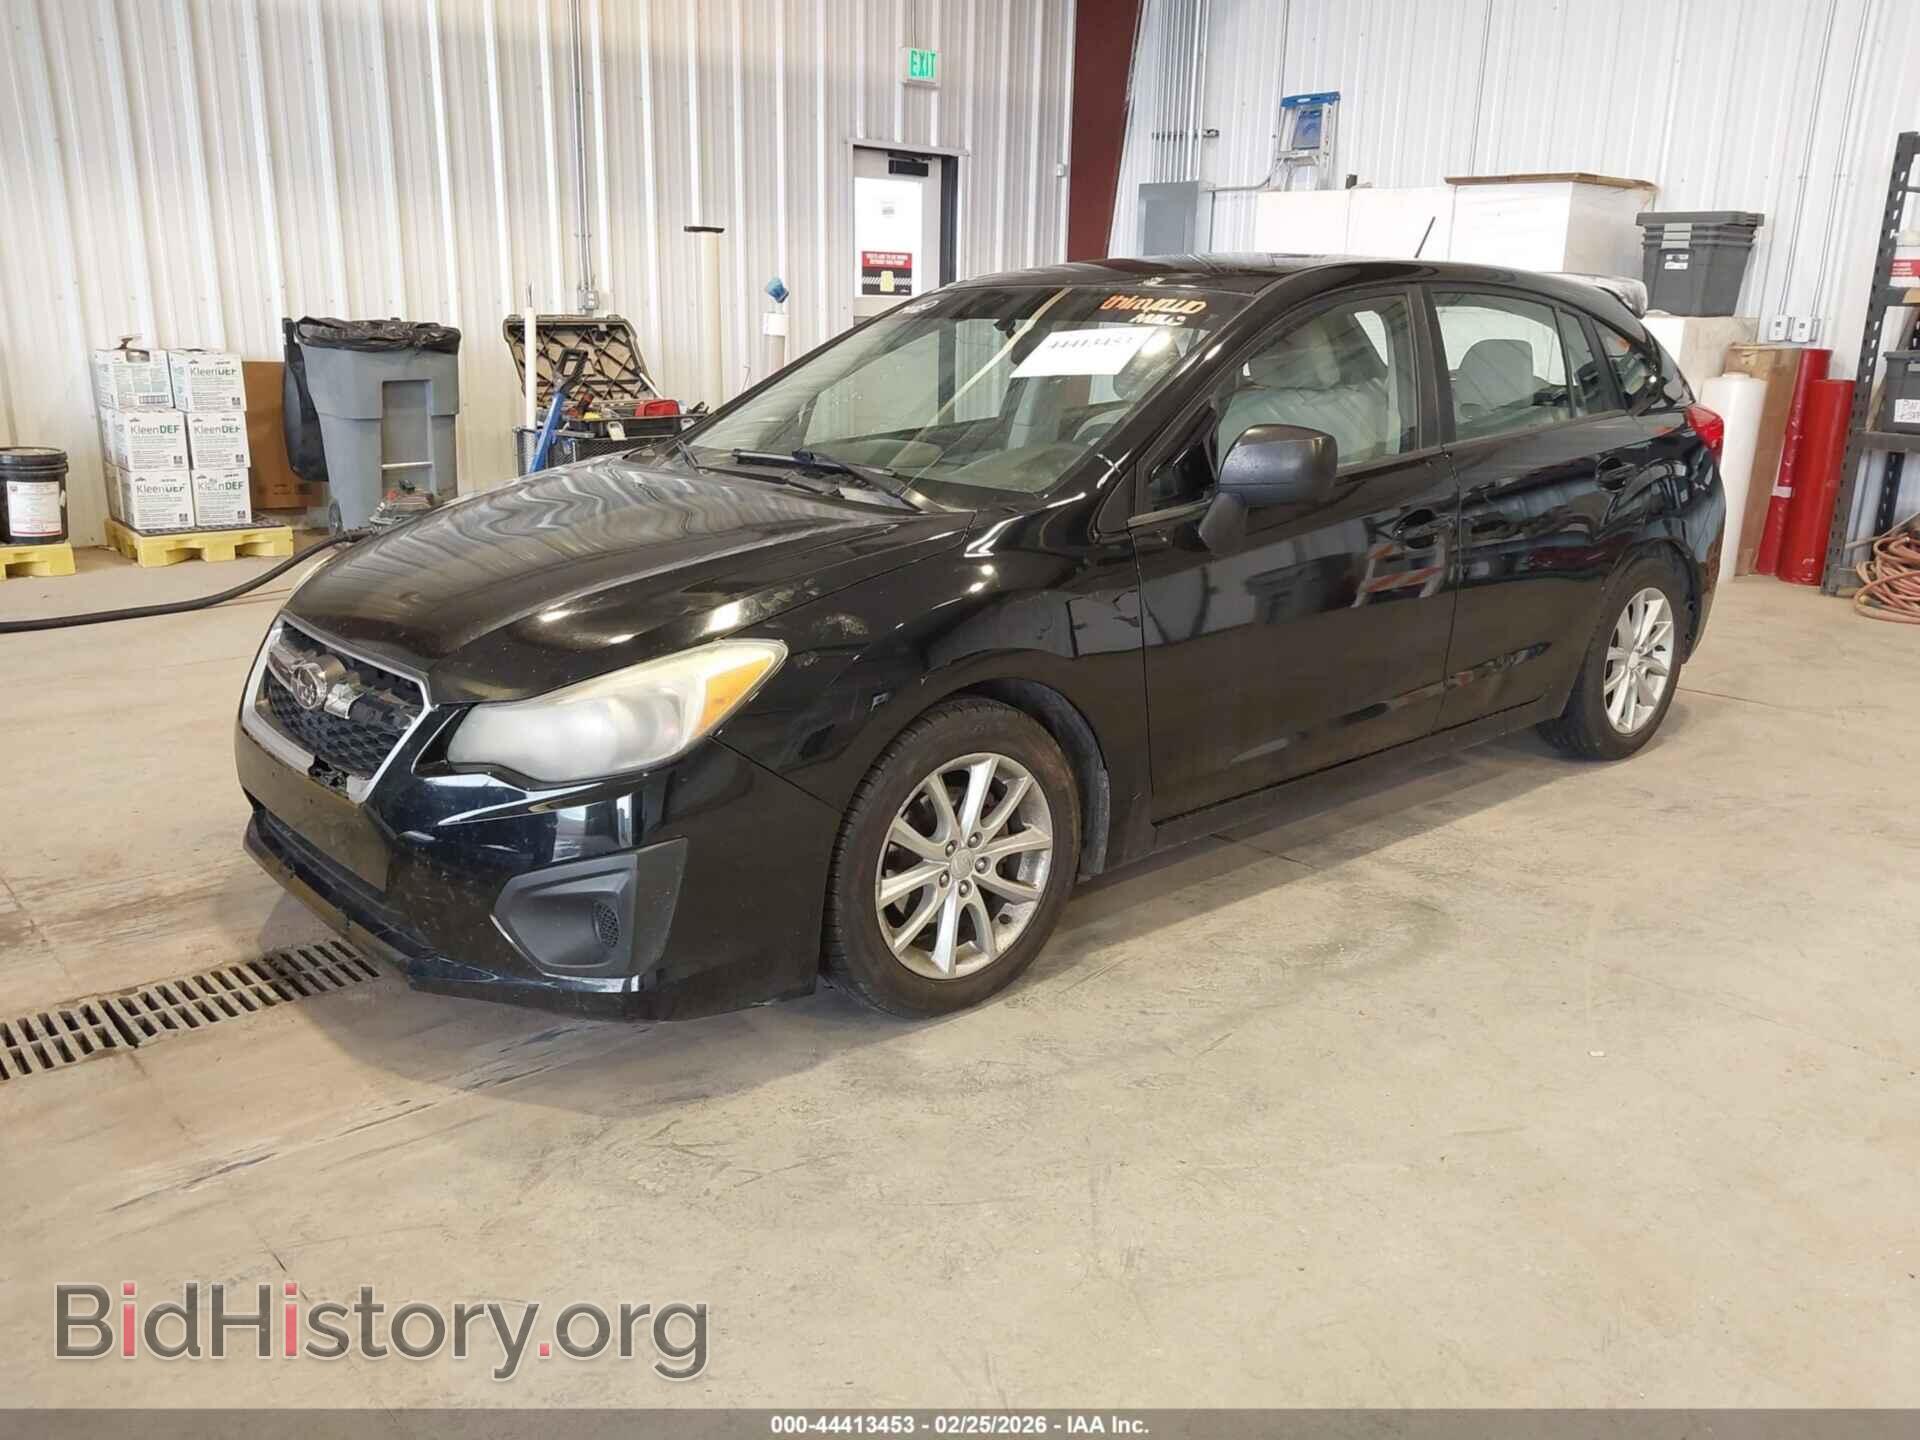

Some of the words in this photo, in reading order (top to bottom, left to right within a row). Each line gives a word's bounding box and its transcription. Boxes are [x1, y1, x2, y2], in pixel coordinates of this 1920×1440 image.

[910, 49, 937, 79] EXIT
[130, 424, 181, 435] KleenDEF
[193, 424, 241, 435] KleenDEF
